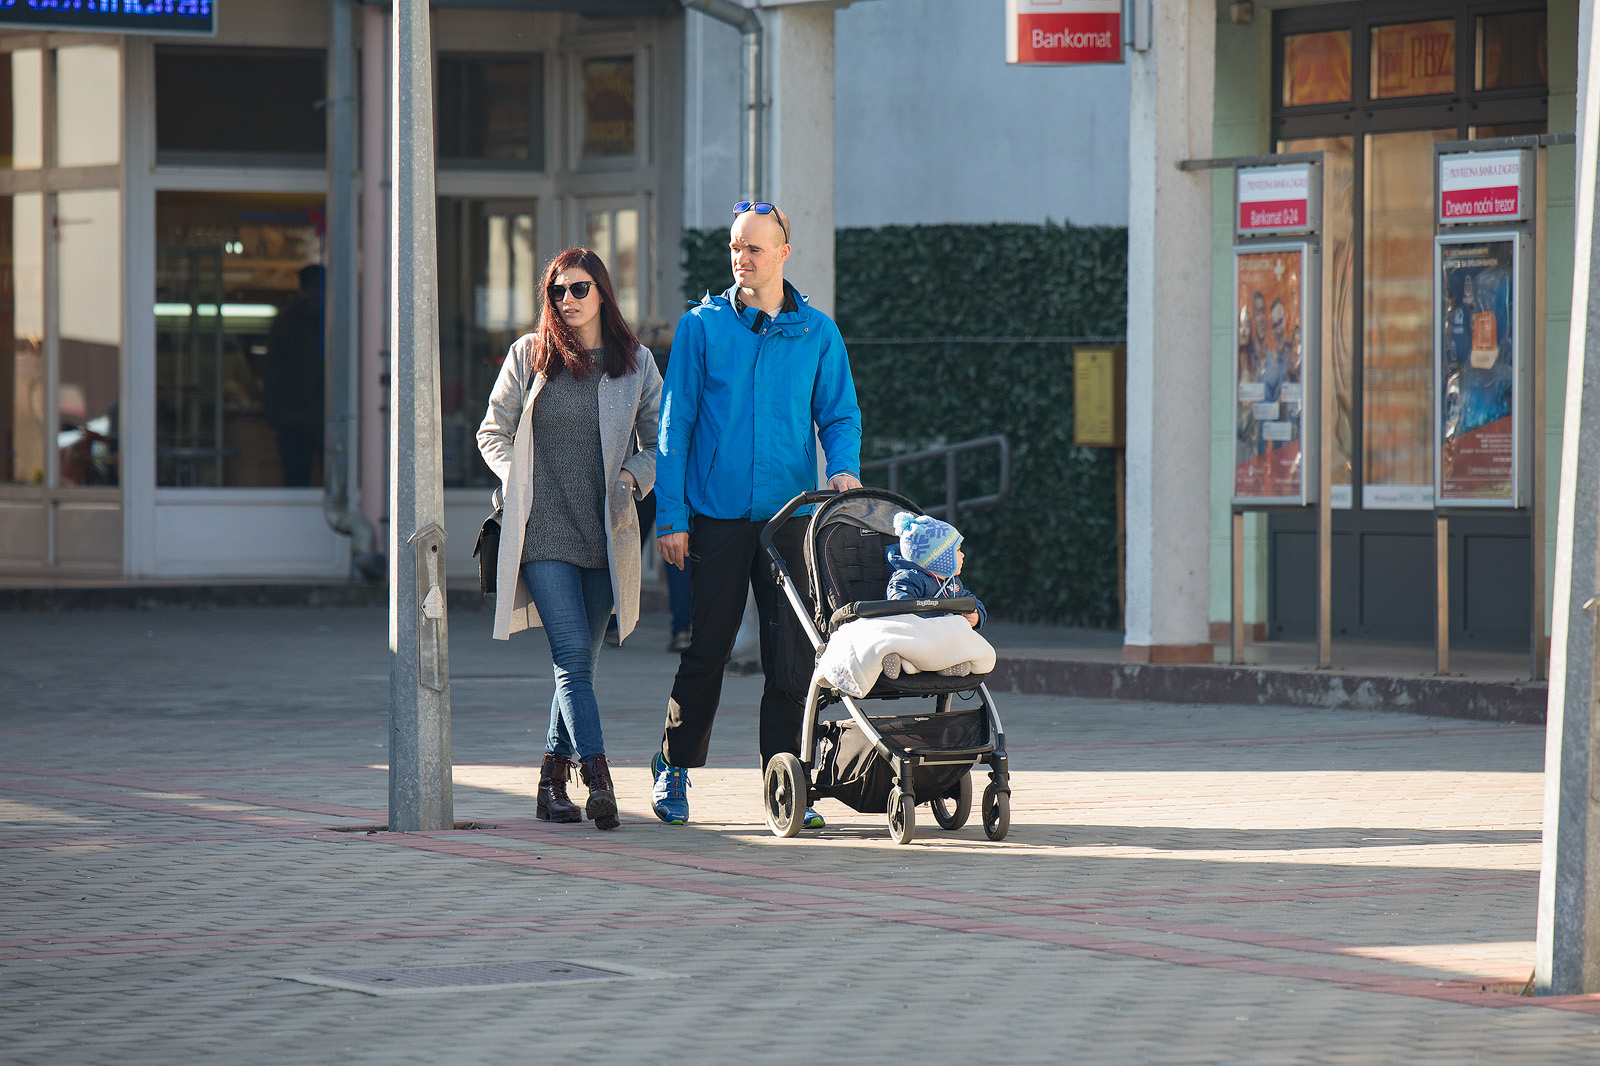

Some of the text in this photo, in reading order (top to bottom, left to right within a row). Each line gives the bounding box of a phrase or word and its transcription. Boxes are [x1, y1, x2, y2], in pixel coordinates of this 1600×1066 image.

[1032, 27, 1112, 48] Bankomat
[1411, 32, 1451, 79] PBZ
[1446, 200, 1473, 216] Dnevno
[1494, 197, 1516, 213] trezor
[1250, 208, 1299, 226] Bankomat 0-24
